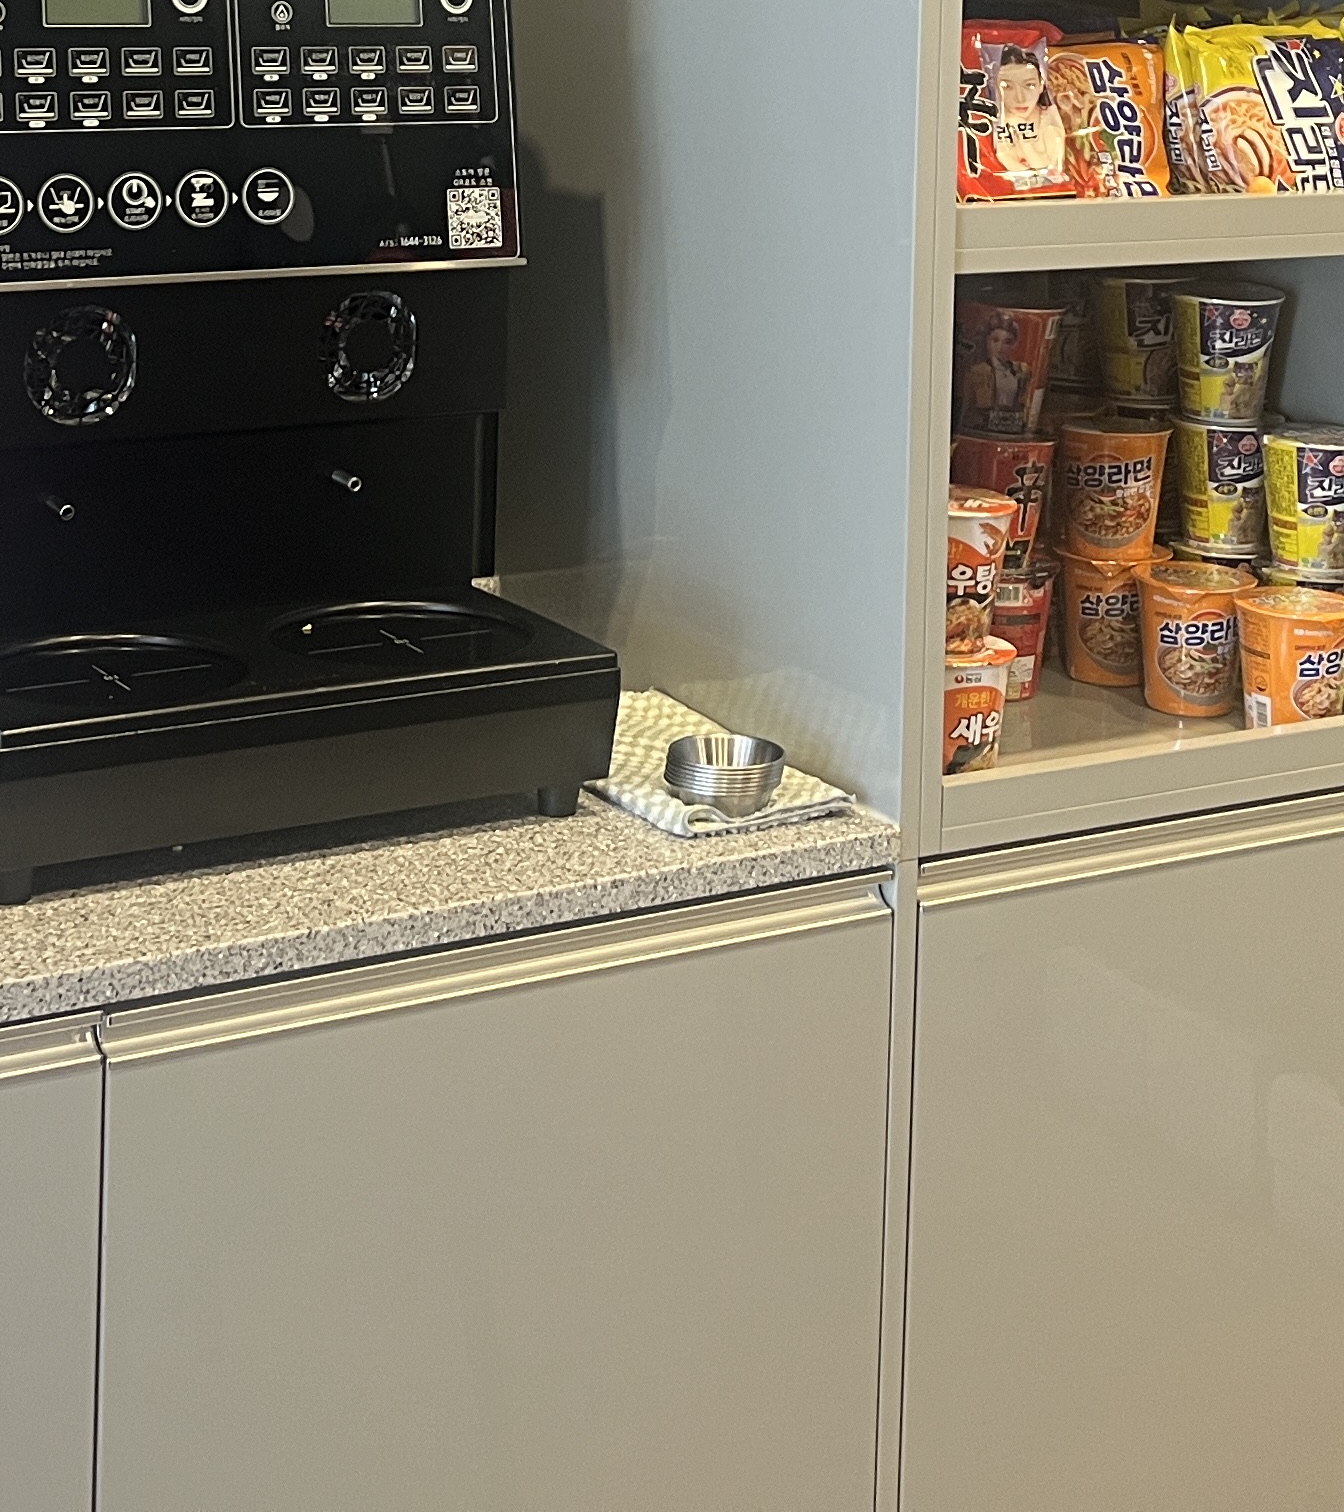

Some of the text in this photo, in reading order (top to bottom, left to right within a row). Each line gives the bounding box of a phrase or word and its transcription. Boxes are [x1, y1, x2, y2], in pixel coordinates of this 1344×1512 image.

[1065, 455, 1153, 488] 삼양라면
[947, 563, 996, 596] 우탕
[950, 711, 1000, 745] 새우
